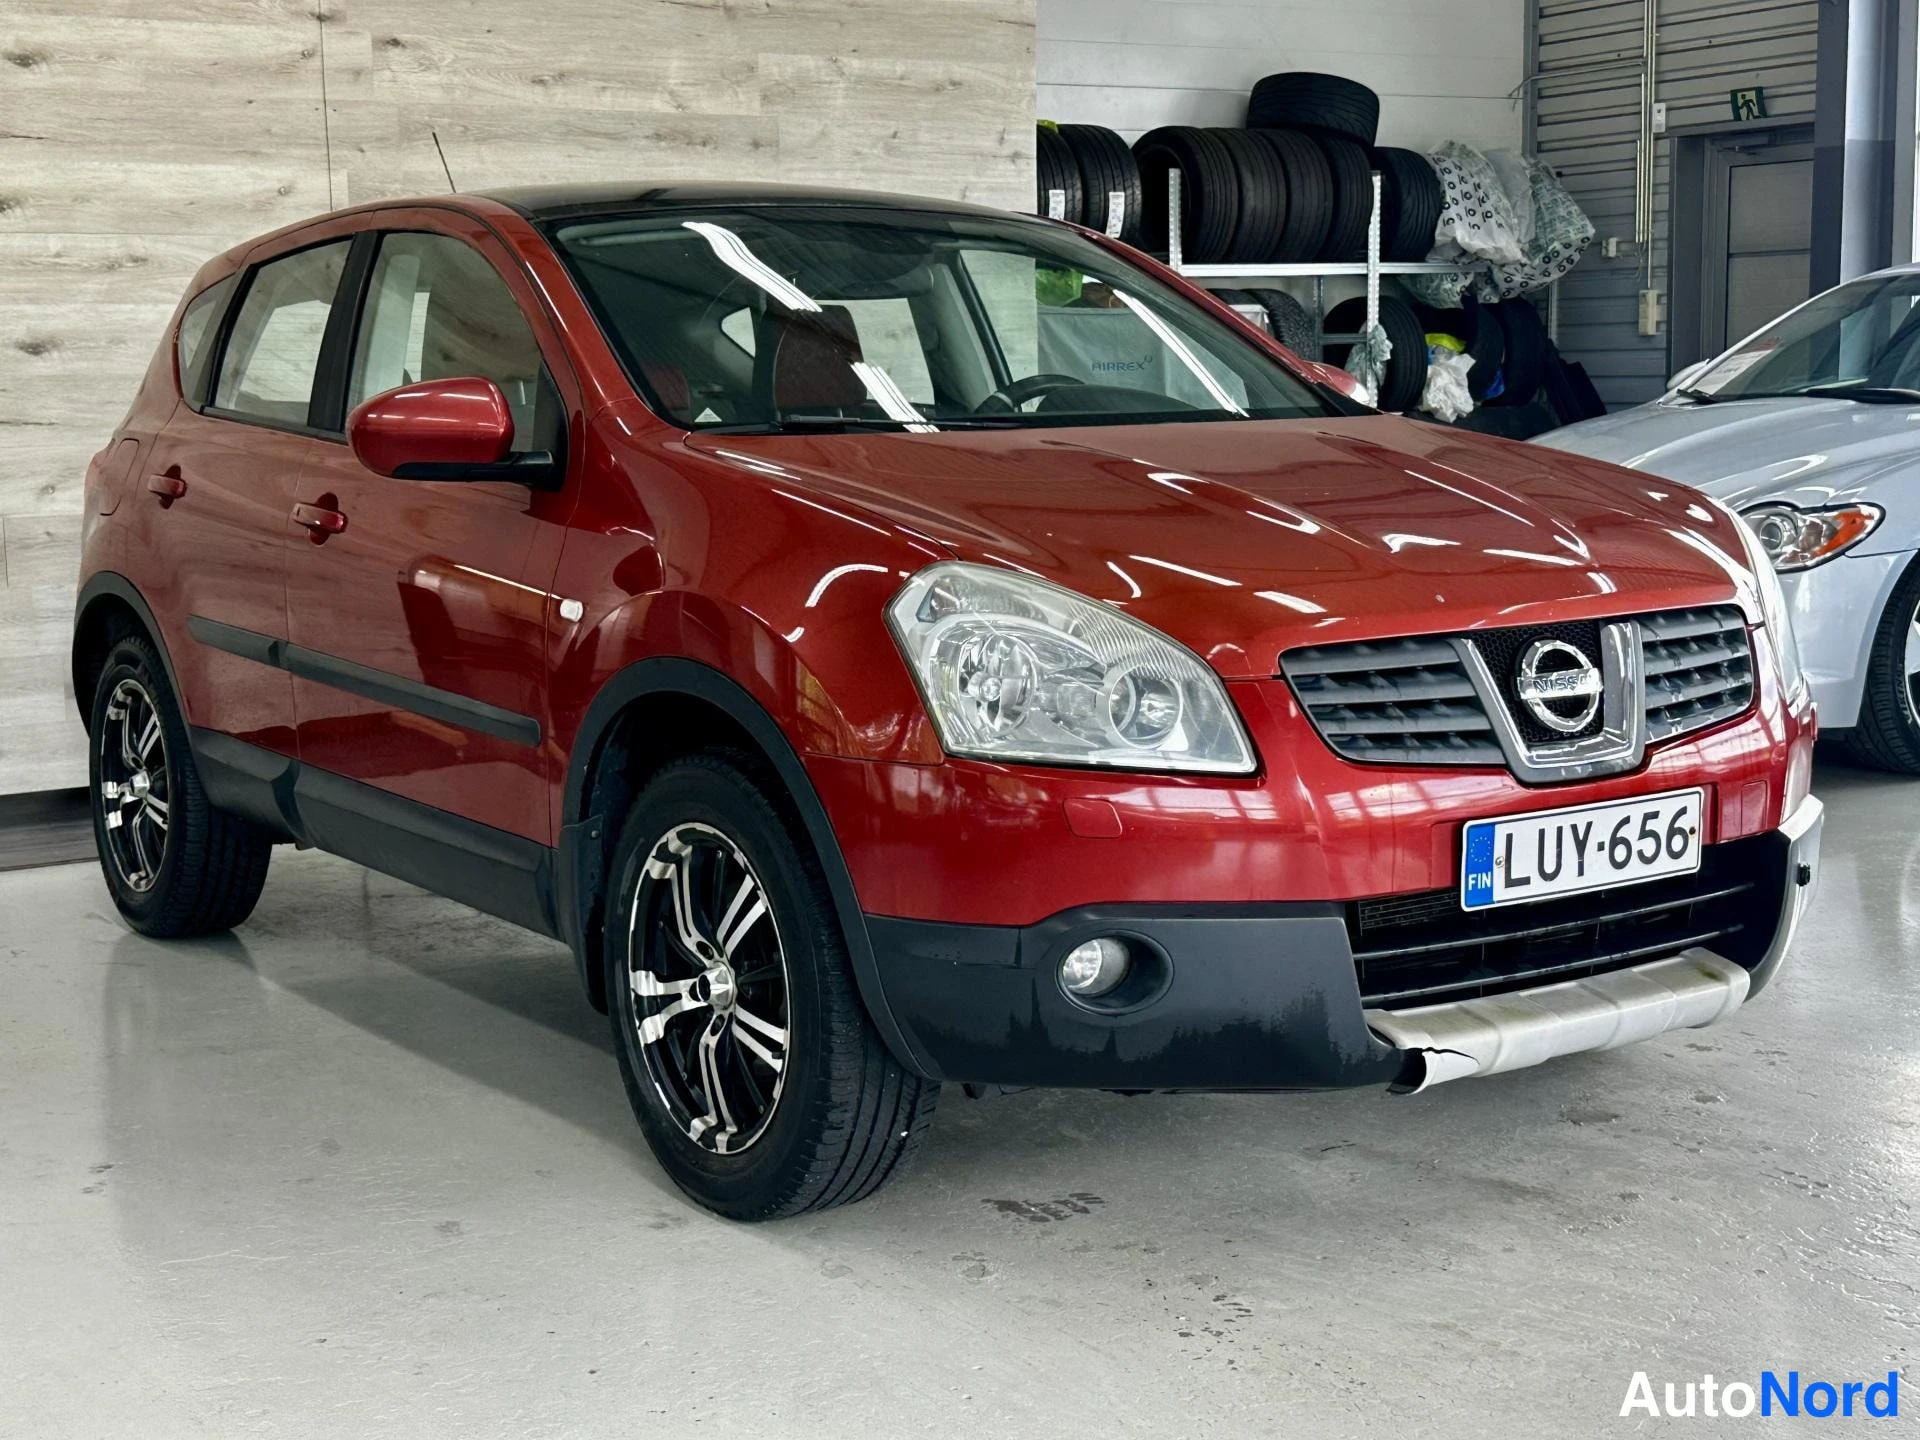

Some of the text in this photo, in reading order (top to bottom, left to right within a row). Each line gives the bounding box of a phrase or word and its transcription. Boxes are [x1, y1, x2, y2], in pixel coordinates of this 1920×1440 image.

[1532, 673, 1593, 693] NISS
[1504, 805, 1689, 889] LUY-656
[1468, 871, 1491, 891] FIN
